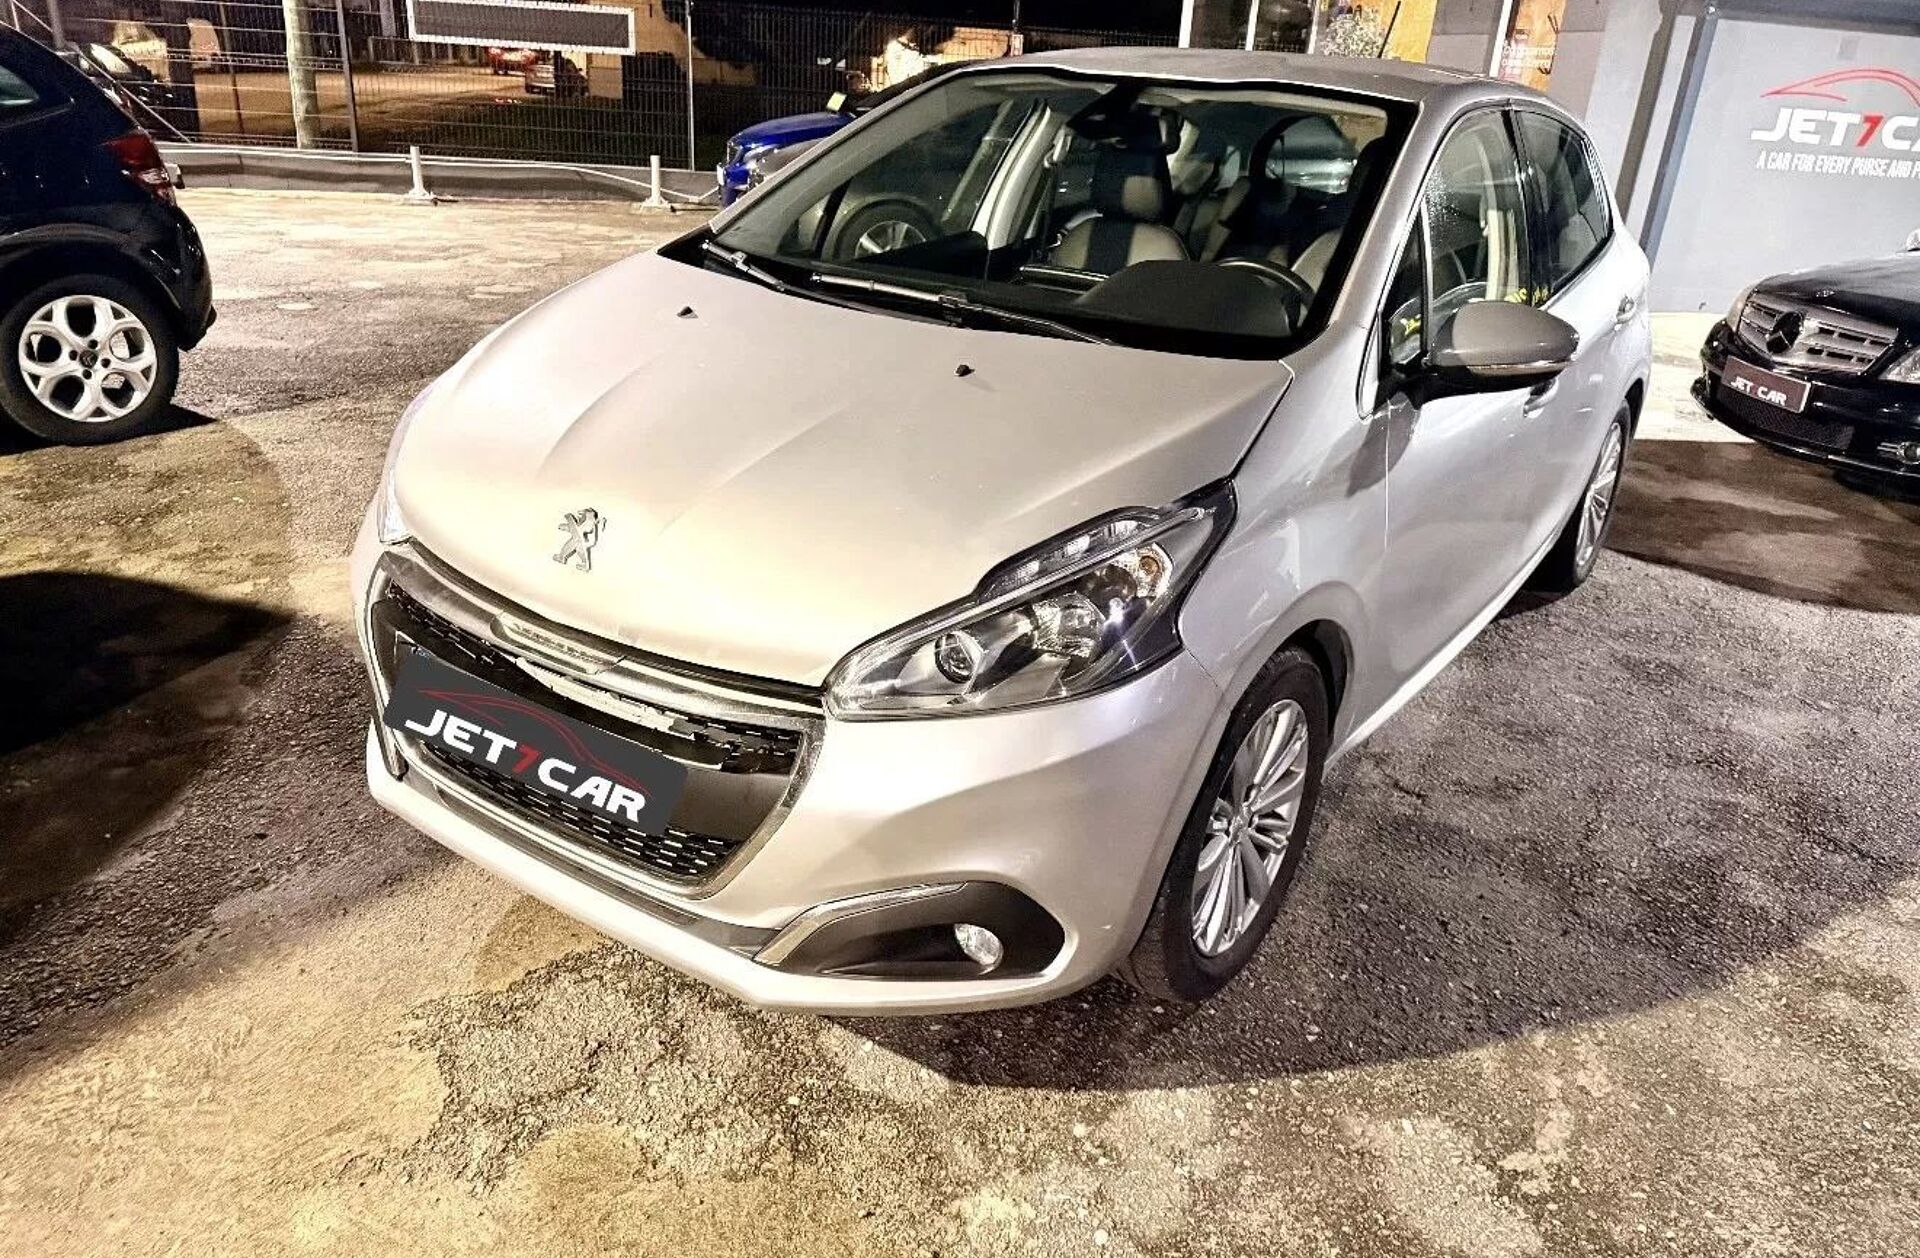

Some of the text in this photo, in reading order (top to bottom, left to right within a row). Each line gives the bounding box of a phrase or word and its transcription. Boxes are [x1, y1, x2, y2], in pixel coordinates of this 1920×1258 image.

[1750, 107, 1920, 152] JET7C
[1757, 151, 1766, 169] A
[1767, 151, 1792, 172] CAR
[1792, 153, 1816, 173] FOR
[1816, 155, 1852, 174] EVERY
[1852, 157, 1890, 177] PURSE
[1887, 159, 1912, 178] AND
